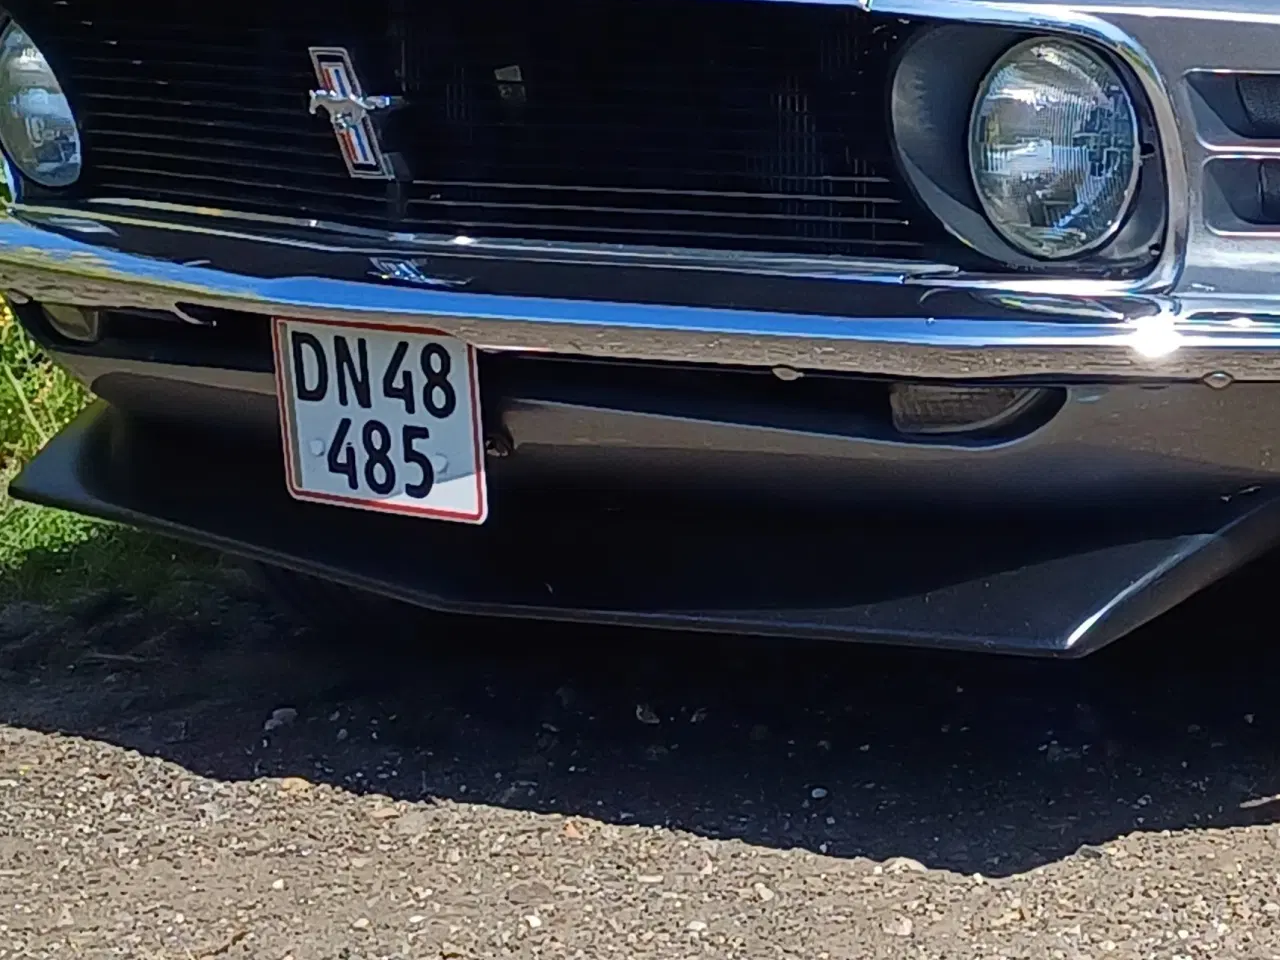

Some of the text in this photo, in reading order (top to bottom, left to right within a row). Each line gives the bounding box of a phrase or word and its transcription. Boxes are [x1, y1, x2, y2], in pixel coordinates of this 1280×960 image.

[291, 331, 456, 418] DN 48
[327, 418, 435, 499] 485
